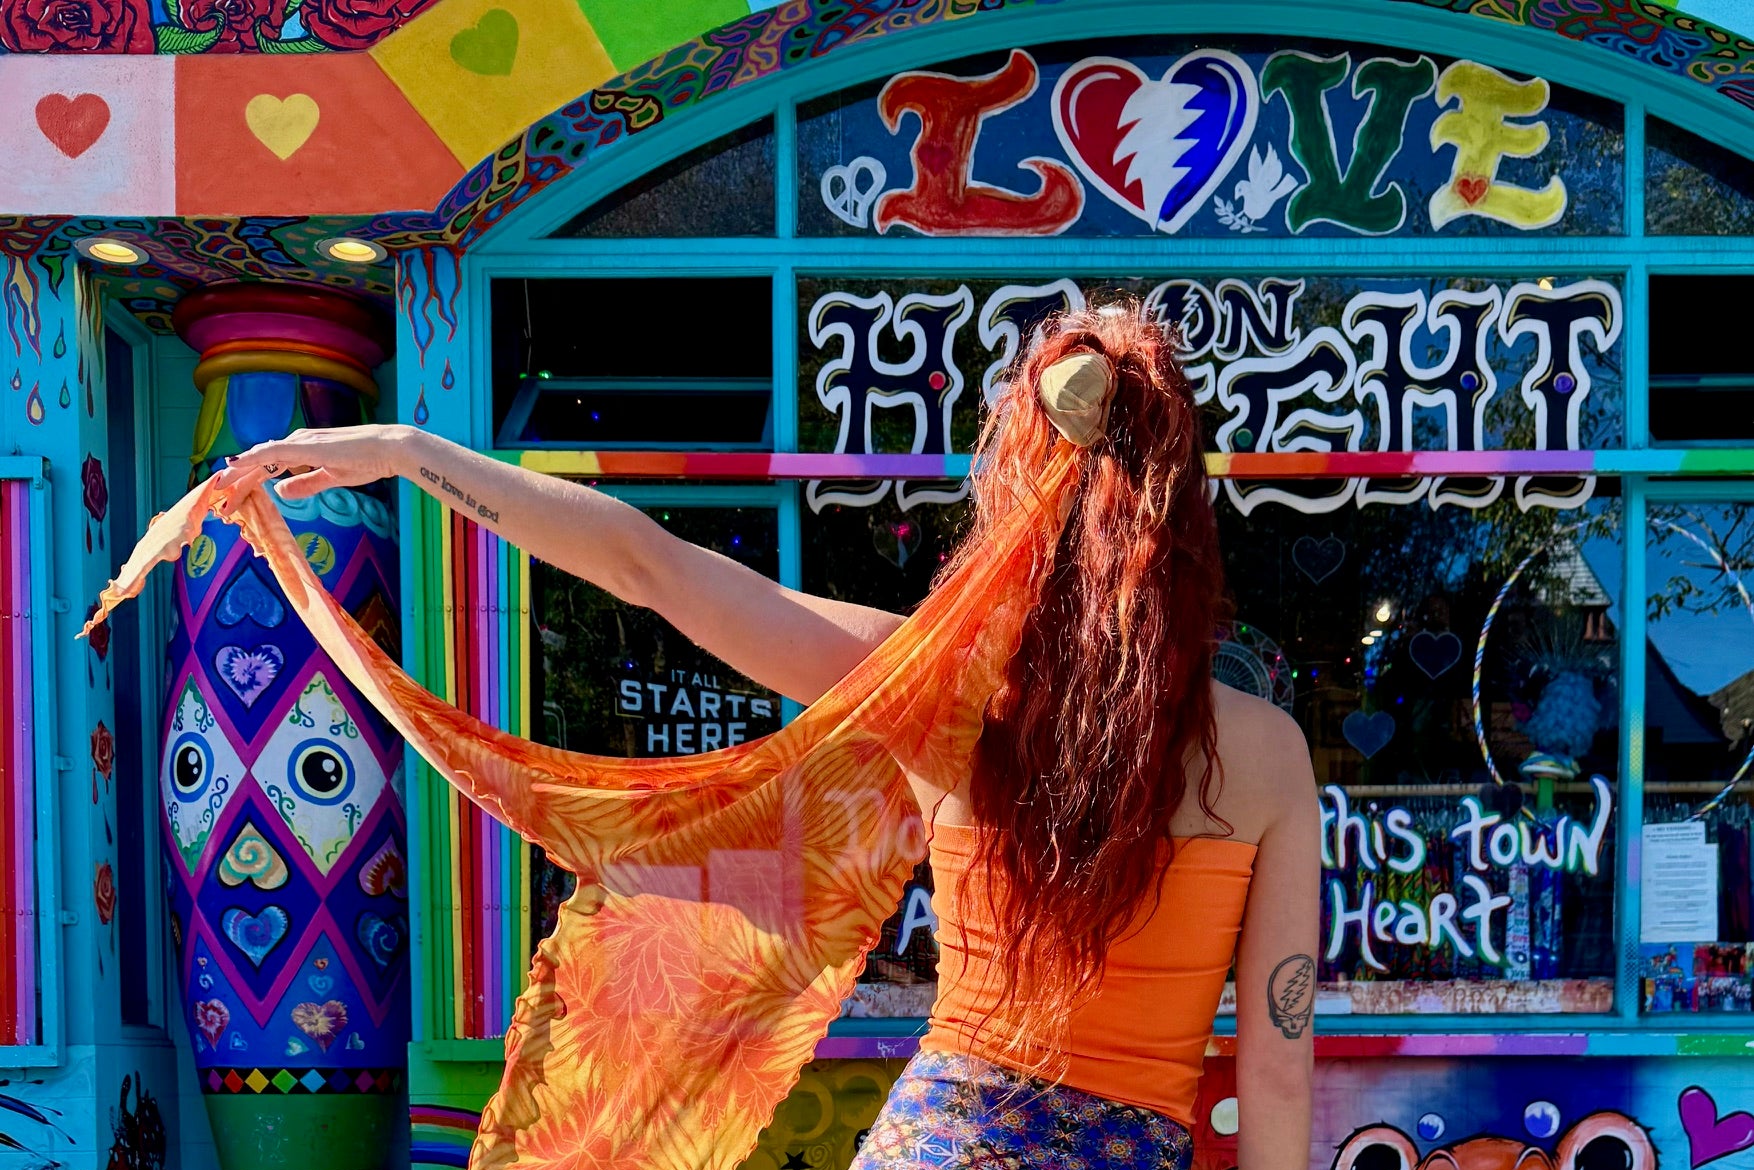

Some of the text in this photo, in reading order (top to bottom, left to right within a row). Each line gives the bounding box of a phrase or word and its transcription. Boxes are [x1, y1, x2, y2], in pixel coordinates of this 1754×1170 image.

[807, 276, 1624, 517] HGHT
[420, 467, 440, 484] our
[671, 669, 721, 690] IT ALL
[620, 679, 773, 719] STARTS
